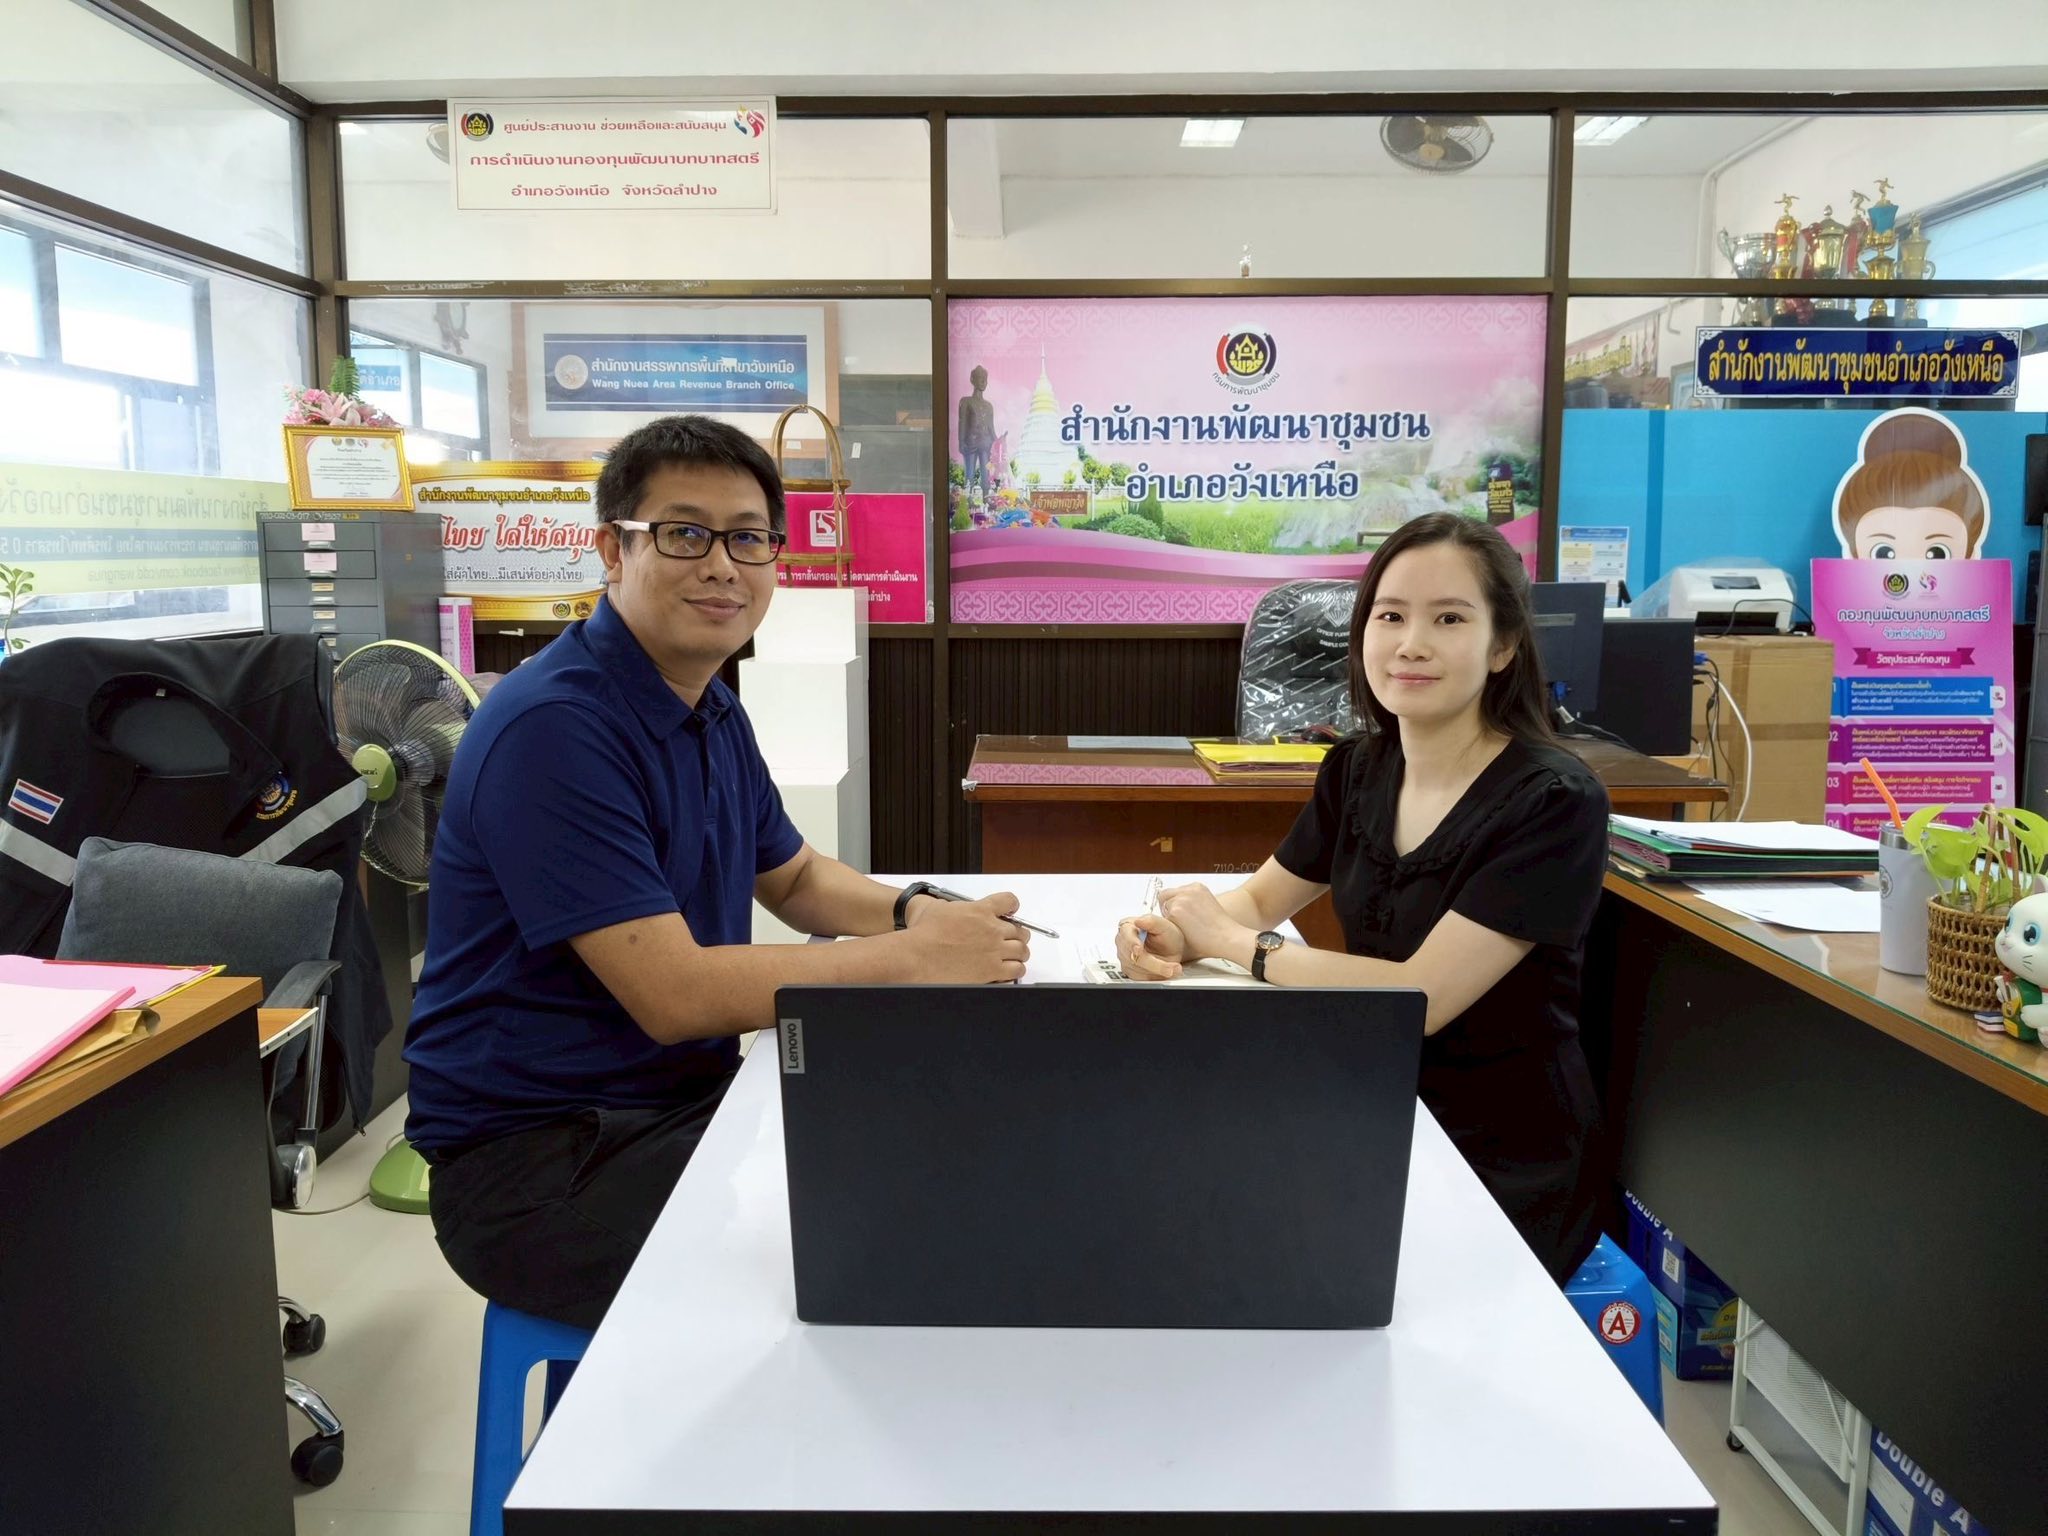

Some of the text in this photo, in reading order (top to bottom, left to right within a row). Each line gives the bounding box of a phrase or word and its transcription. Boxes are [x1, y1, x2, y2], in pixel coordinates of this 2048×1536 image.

[504, 118, 727, 133] ศูนย์ประสานงาน ช่วยเหลือและสนับสนุน
[470, 152, 760, 169] การดำเนินงานกองทุนพัฒนาบทบาทสตรี
[511, 184, 717, 197] อำเภอวังเหนือ จังหวัดลำปาง
[1708, 338, 2004, 395] สำนักงานพัฒนาชุมชนอำเภอวังเหนือ
[592, 380, 795, 391] Wang Nuea Area Revenue Branch Office
[1060, 404, 1431, 451] สำนักงานพัฒนาชุมชน
[1126, 460, 1360, 500] อำเภอวังเหนือ
[1838, 606, 1990, 626] กองทุนพัฒนาบทบาทสตรี
[1877, 652, 1950, 665] วัตถุประสงค์กองทุน
[1826, 777, 1839, 788] 03
[786, 1022, 799, 1070] Lenovo
[1608, 1310, 1628, 1336] A
[1949, 1506, 1970, 1535] A
